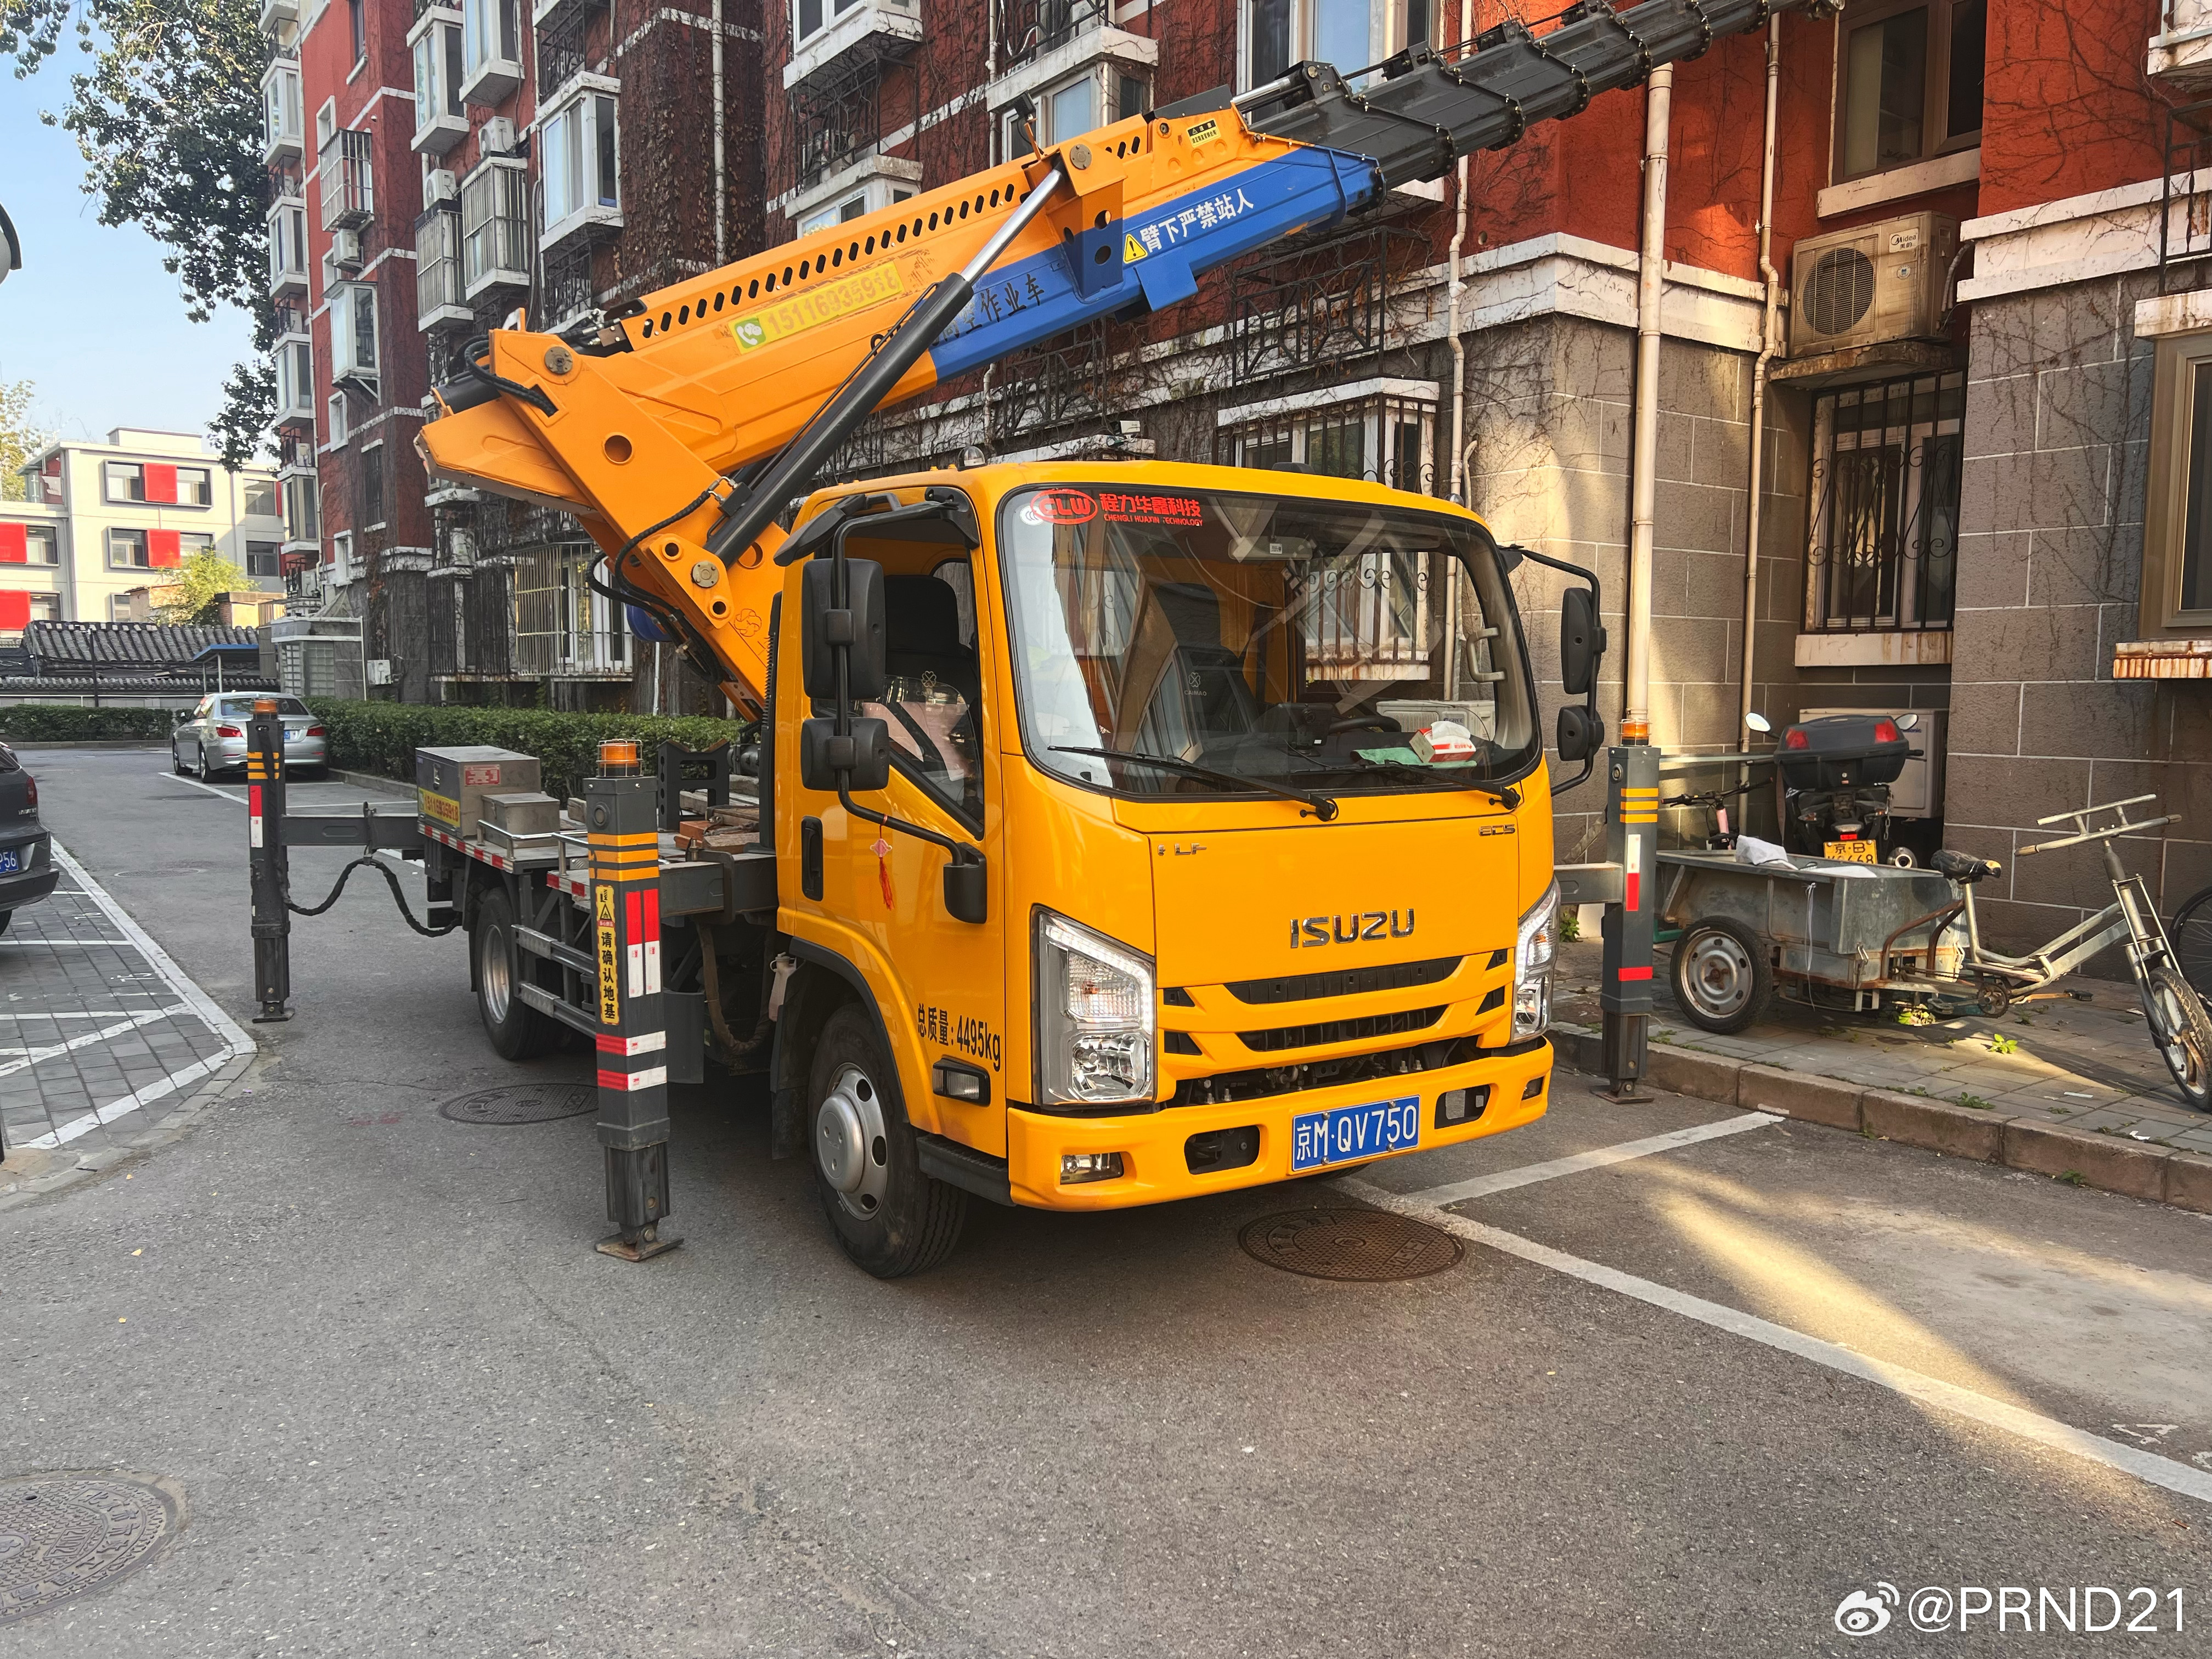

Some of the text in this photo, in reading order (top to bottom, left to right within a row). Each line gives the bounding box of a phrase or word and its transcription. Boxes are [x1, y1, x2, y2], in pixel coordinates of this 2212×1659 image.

[1139, 188, 1254, 253] 臂下严禁站人
[1891, 234, 1916, 245] Midea
[1039, 498, 1091, 515] CLW
[1099, 493, 1202, 517] 程力华鑫科技
[1103, 513, 1133, 522] CHENGLI
[1135, 515, 1160, 523] HUAXIN
[1290, 908, 1415, 949] ISUZU
[601, 932, 616, 1019] 请确认地基
[1296, 1105, 1417, 1161] 京M·QV750
